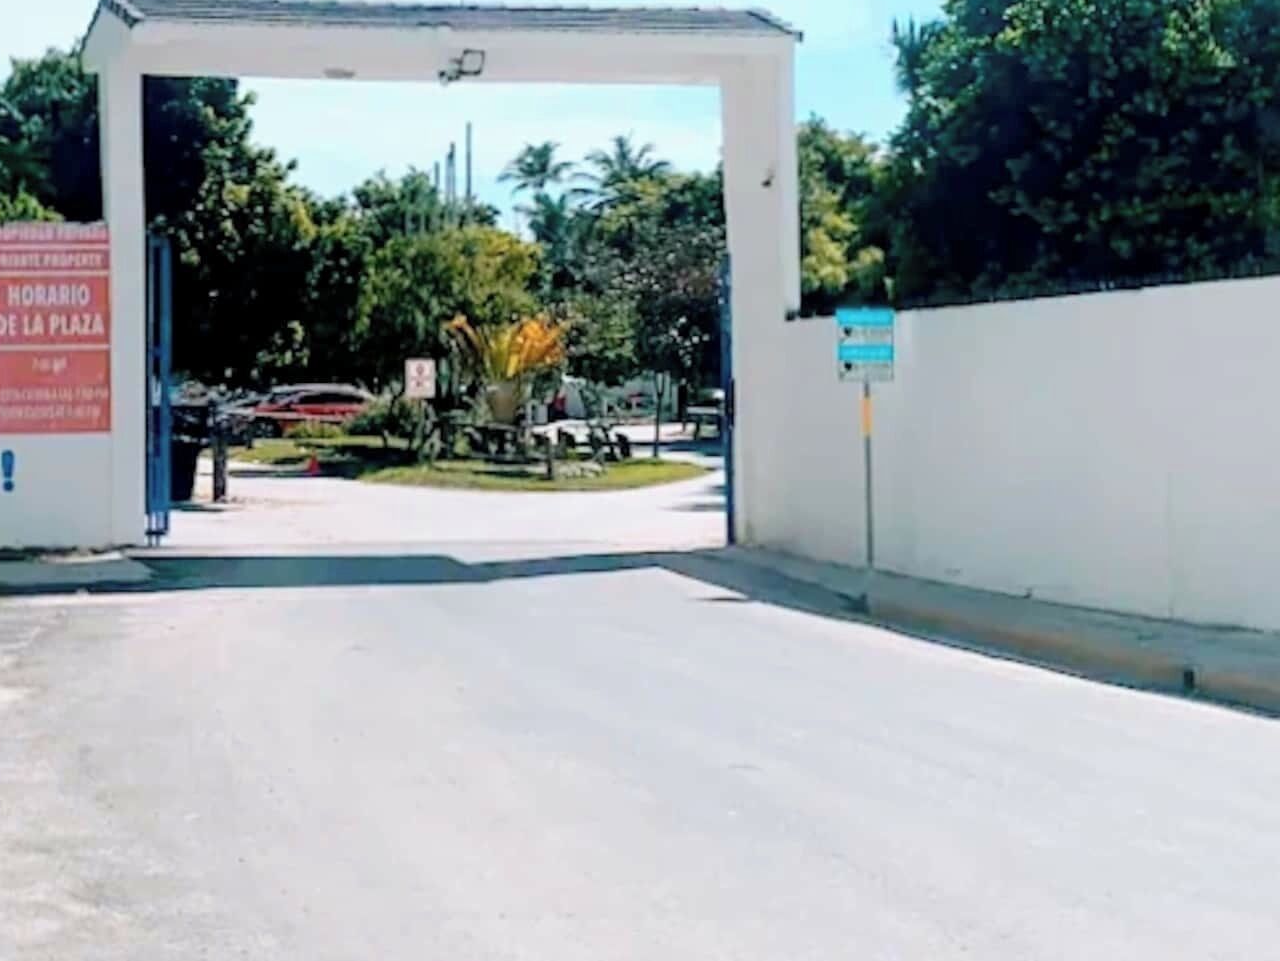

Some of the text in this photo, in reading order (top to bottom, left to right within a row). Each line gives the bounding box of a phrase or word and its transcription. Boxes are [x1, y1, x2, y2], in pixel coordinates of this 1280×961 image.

[7, 284, 90, 307] HORARIO
[23, 313, 44, 336] LA
[49, 313, 105, 336] PLAZA
